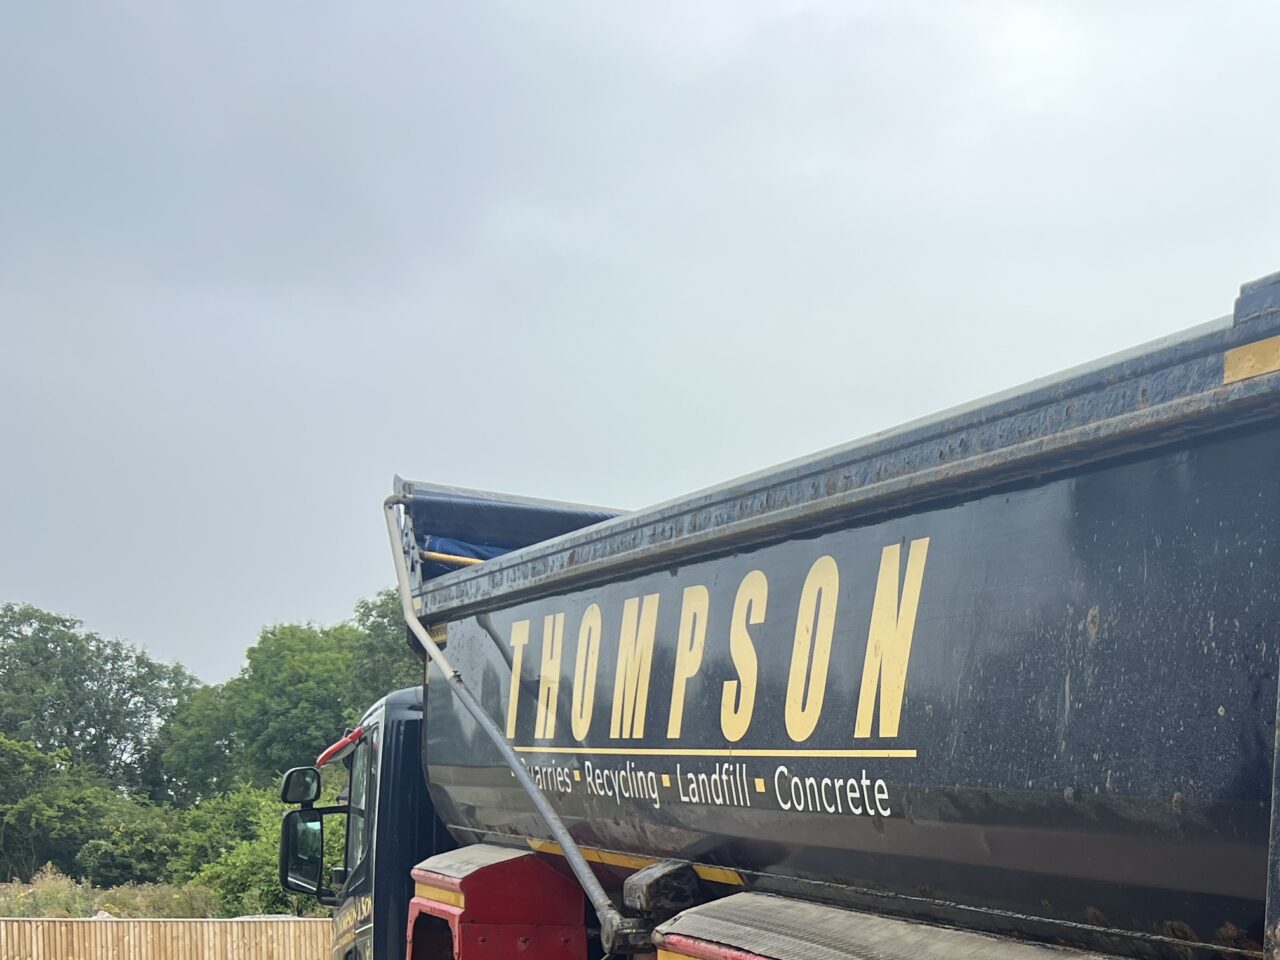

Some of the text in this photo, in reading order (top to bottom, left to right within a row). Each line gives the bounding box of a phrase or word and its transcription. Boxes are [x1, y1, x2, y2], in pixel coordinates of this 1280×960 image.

[506, 537, 930, 742] THOMPSON
[520, 757, 891, 816] arries Recycling Landfill Concrete
